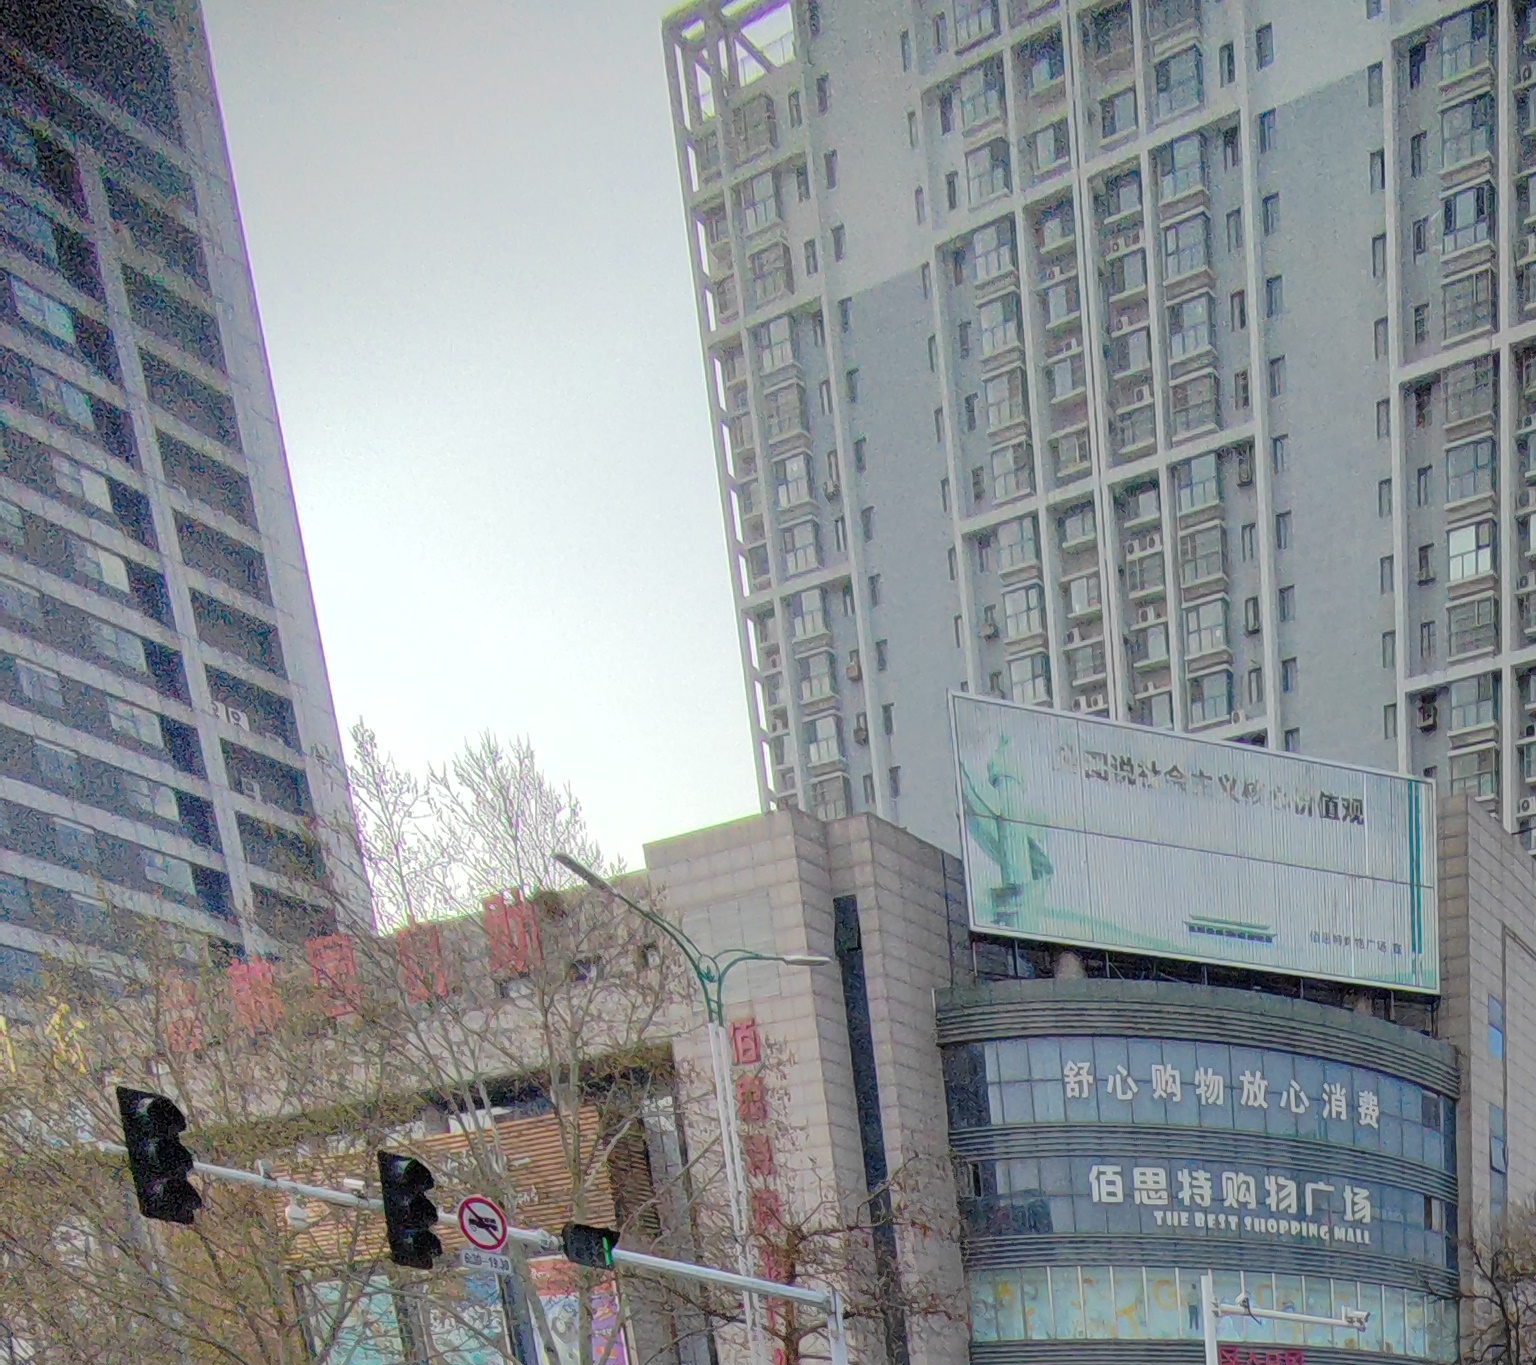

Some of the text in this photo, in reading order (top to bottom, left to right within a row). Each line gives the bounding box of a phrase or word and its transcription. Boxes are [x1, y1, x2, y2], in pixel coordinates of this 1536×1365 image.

[1063, 1060, 1379, 1129] 舒心购物放心消费
[1090, 1164, 1371, 1224] 佰思特购物广场
[1153, 1211, 1371, 1244] THE BEST SHOPPING MALL
